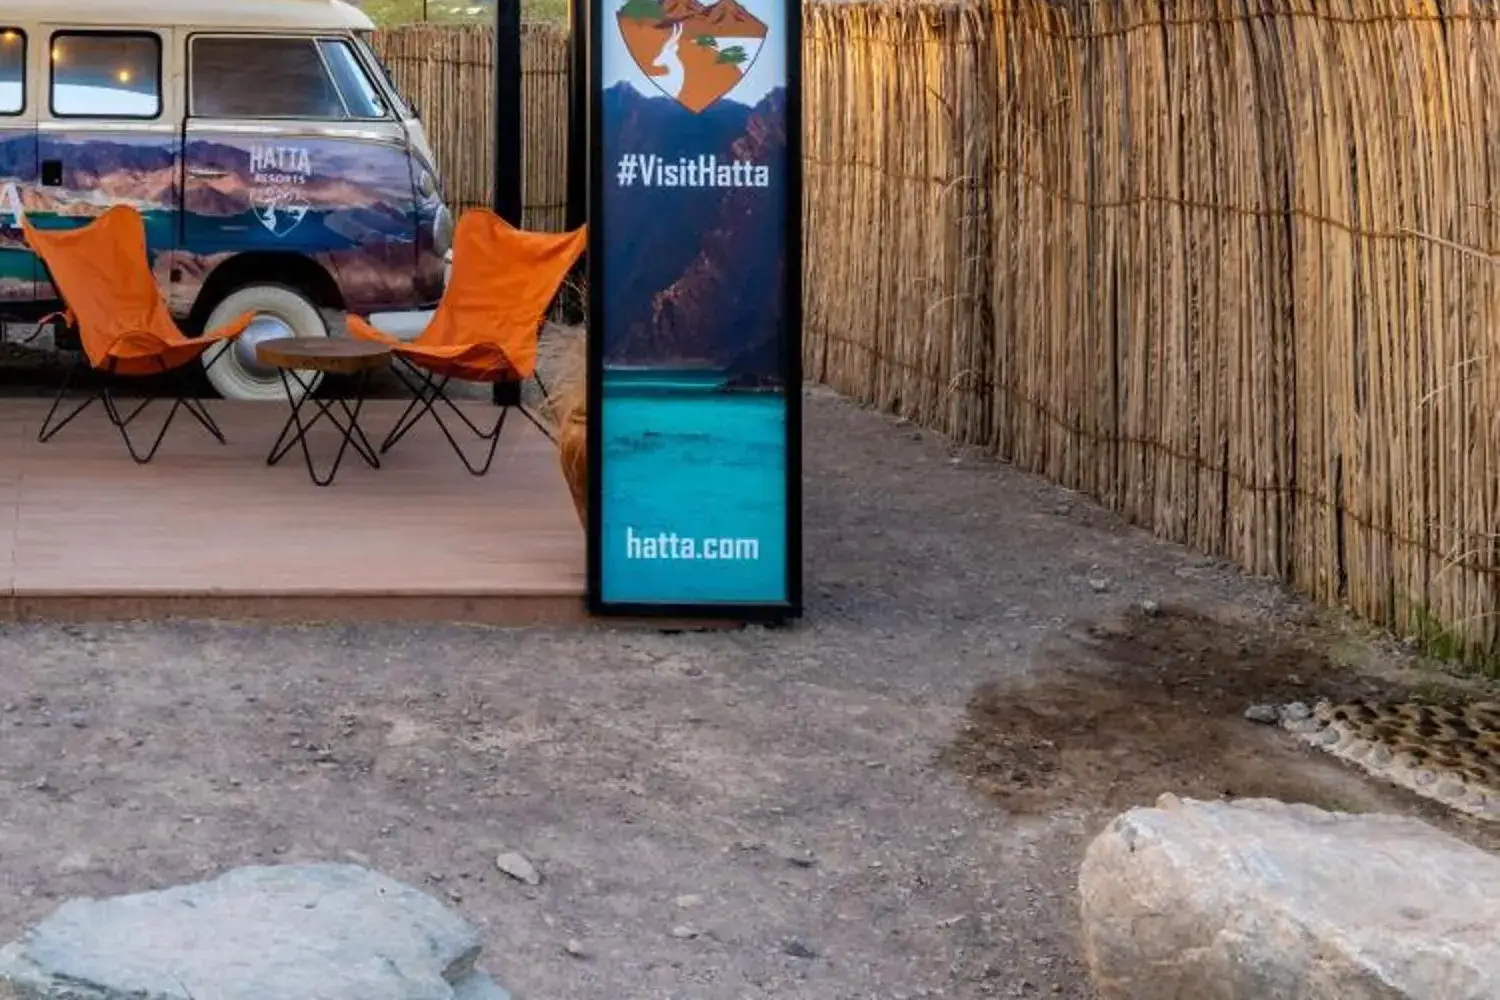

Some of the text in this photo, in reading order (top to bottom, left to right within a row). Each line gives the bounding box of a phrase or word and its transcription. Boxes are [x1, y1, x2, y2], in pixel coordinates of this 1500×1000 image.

[249, 145, 311, 176] HATTA
[616, 153, 769, 188] #VisitHatta
[626, 526, 759, 560] hatta.com
